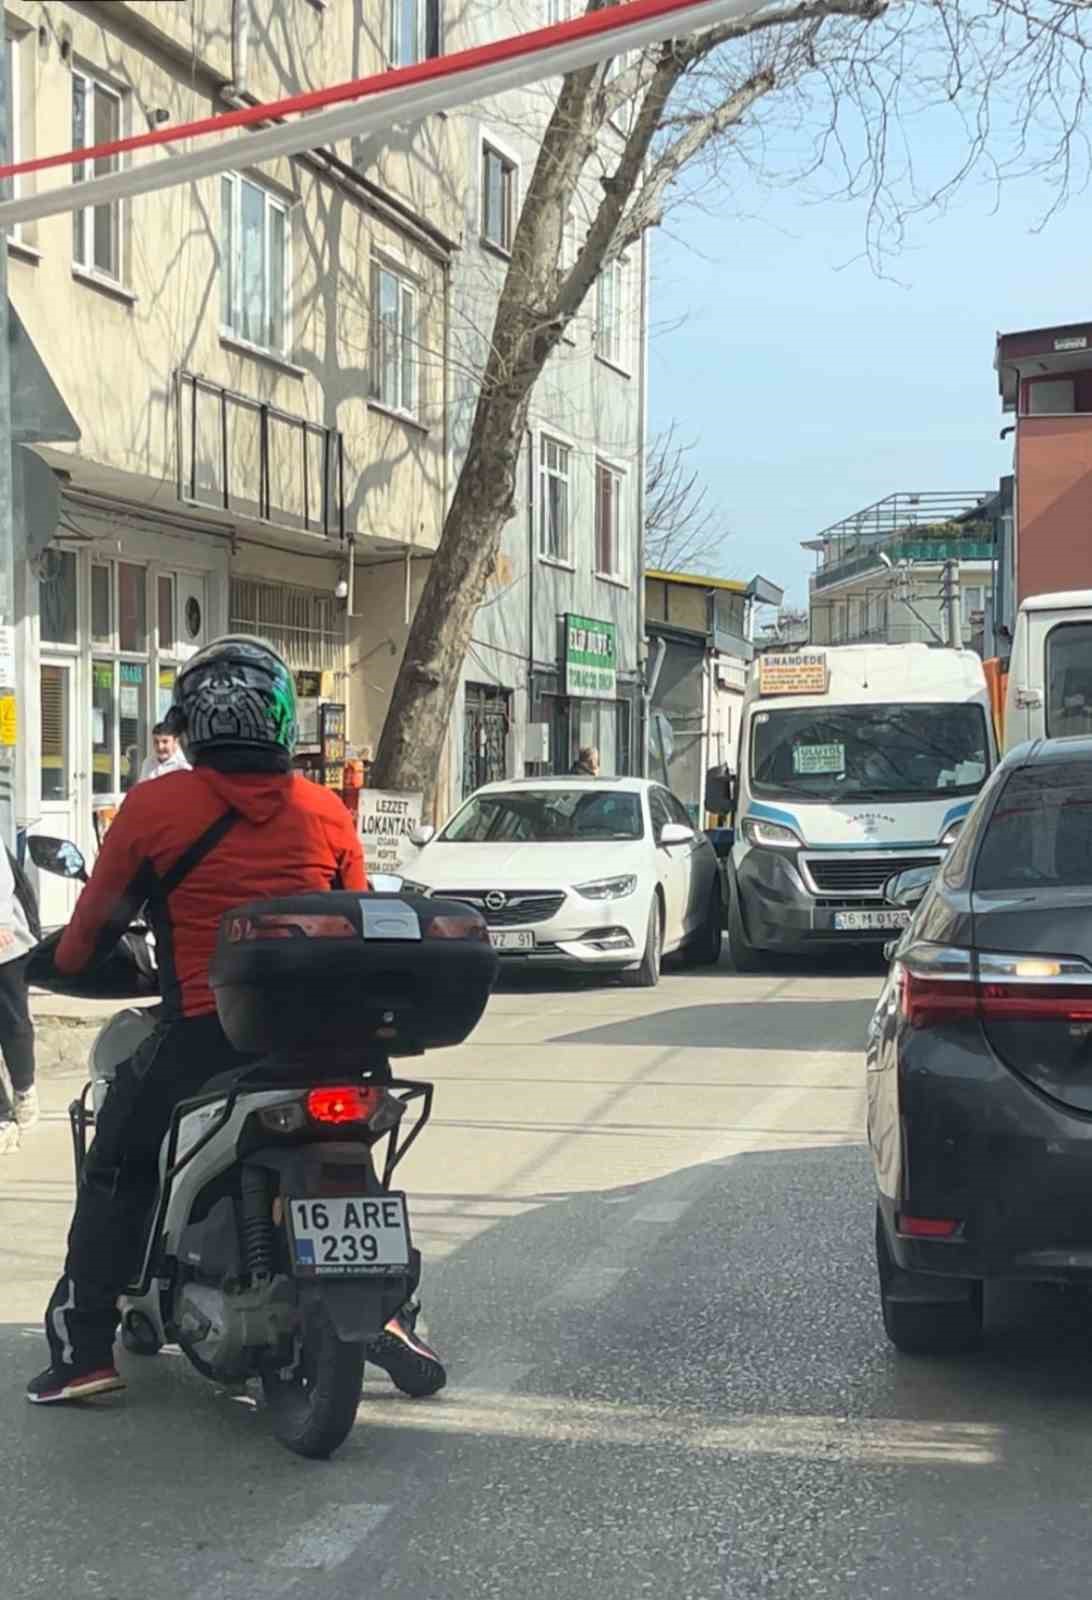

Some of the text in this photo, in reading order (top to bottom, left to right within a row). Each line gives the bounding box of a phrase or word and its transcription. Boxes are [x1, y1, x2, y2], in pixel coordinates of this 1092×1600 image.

[375, 799, 409, 814] LEZZET
[518, 933, 530, 946] 91
[297, 1201, 401, 1230] 16 ARE
[321, 1234, 379, 1262] 239
